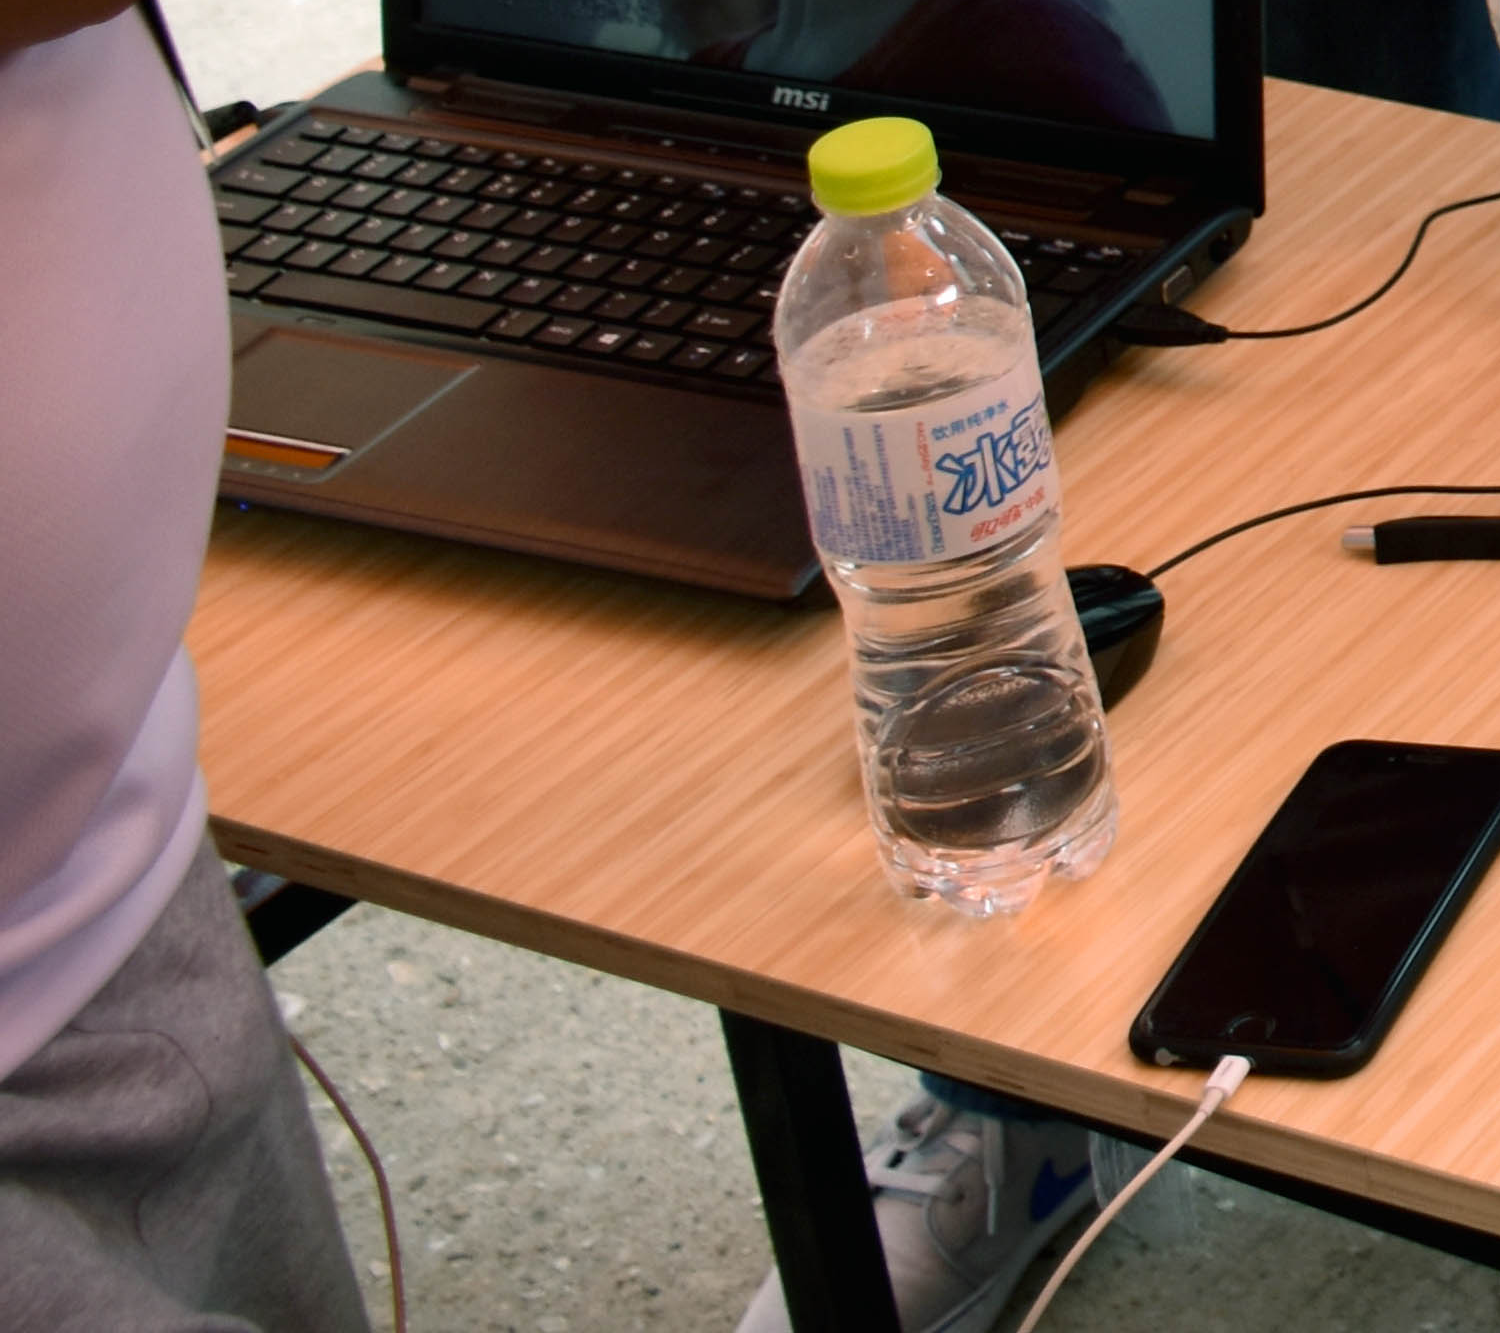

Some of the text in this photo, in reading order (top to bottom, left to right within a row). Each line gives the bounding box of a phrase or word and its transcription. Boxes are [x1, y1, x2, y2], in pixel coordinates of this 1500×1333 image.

[772, 85, 831, 111] msi
[931, 398, 1009, 442] 饮用纯净水
